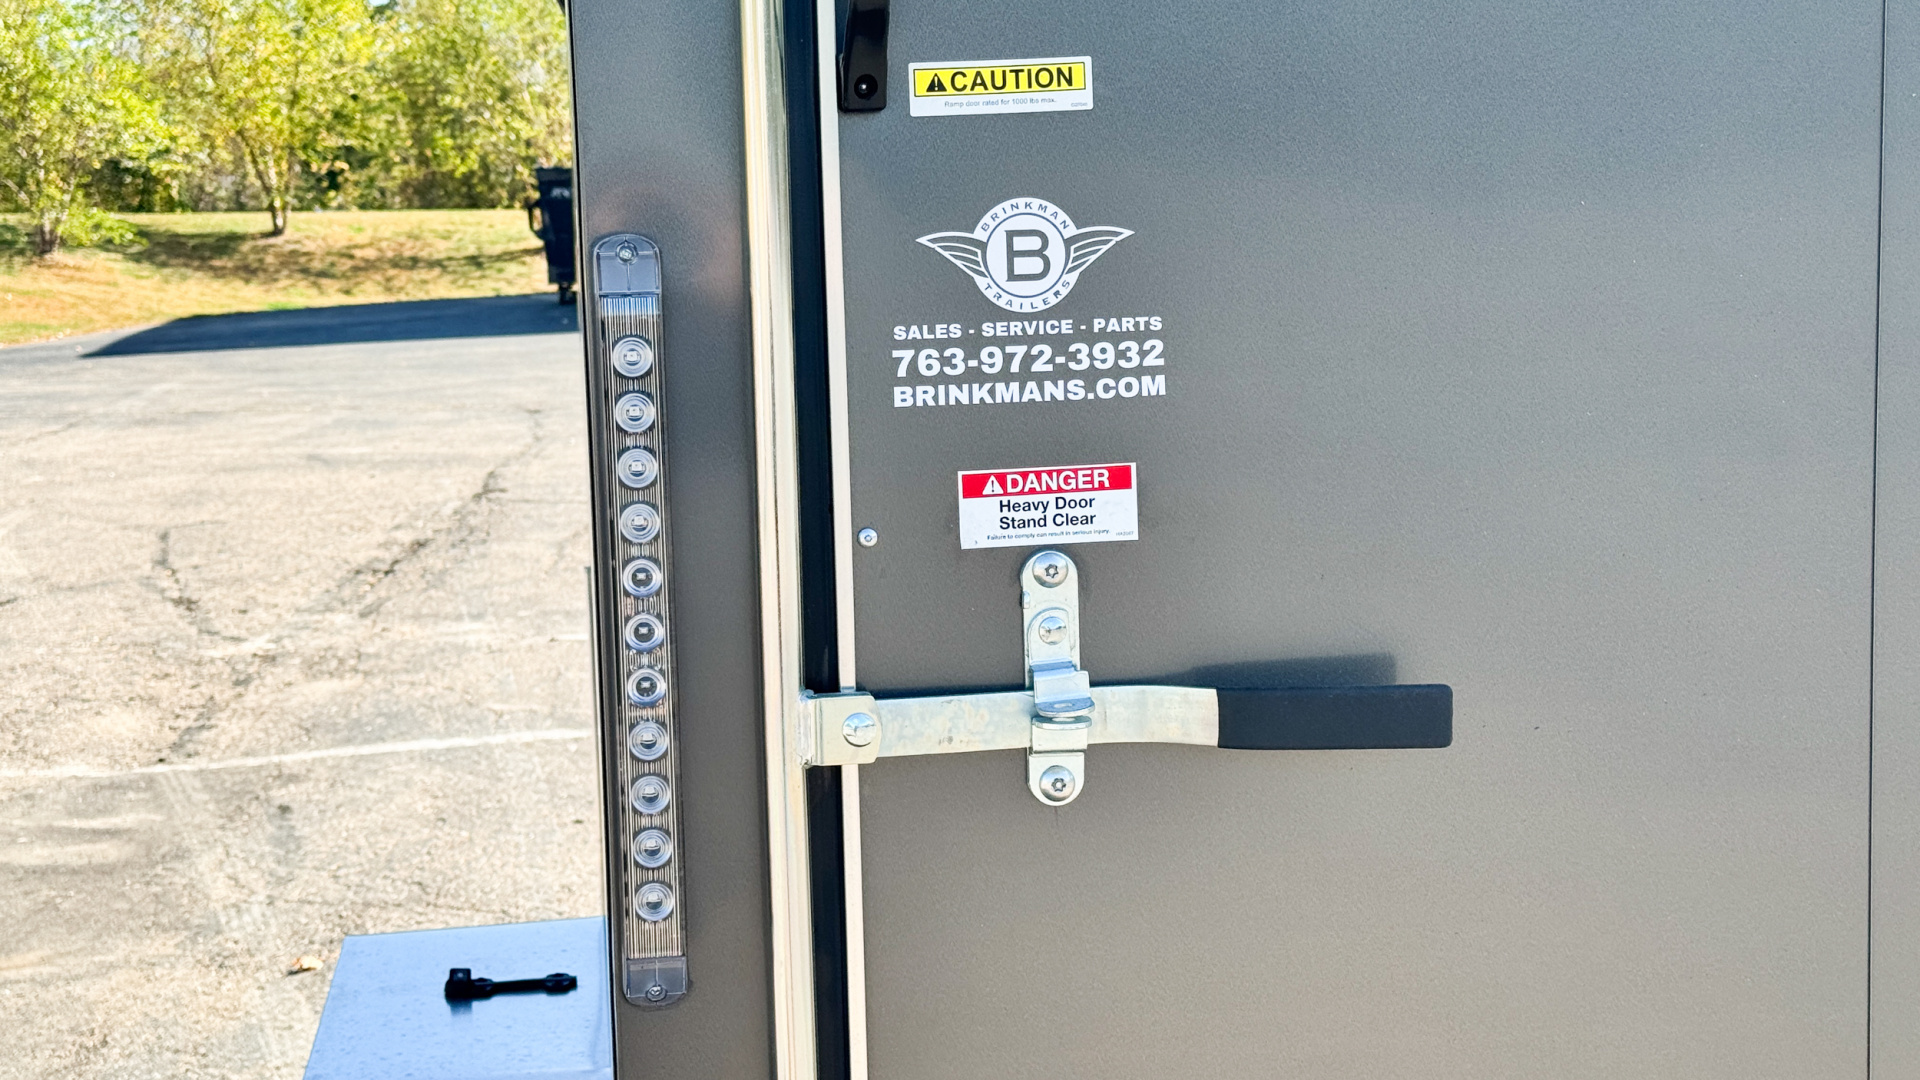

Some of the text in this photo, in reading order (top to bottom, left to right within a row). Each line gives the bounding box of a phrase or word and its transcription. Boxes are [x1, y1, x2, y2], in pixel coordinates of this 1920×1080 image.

[950, 66, 1073, 92] CAUTION
[944, 100, 964, 108] Ramp
[965, 99, 980, 107] door
[1000, 98, 1010, 106] for
[1012, 97, 1028, 105] 1000
[980, 201, 1070, 233] BRINKMAN
[1004, 229, 1051, 282] B
[983, 279, 1070, 310] TRAILERS
[893, 323, 962, 340] SALES
[981, 319, 1073, 337] SERVICE
[1093, 316, 1162, 333] PARTS
[892, 339, 1165, 377] 763-972-3932
[893, 374, 1166, 408] BRINKMANS.COM
[1006, 469, 1110, 493] DANGER
[999, 496, 1096, 514] Heavy Door
[999, 513, 1096, 530] Stand Clear
